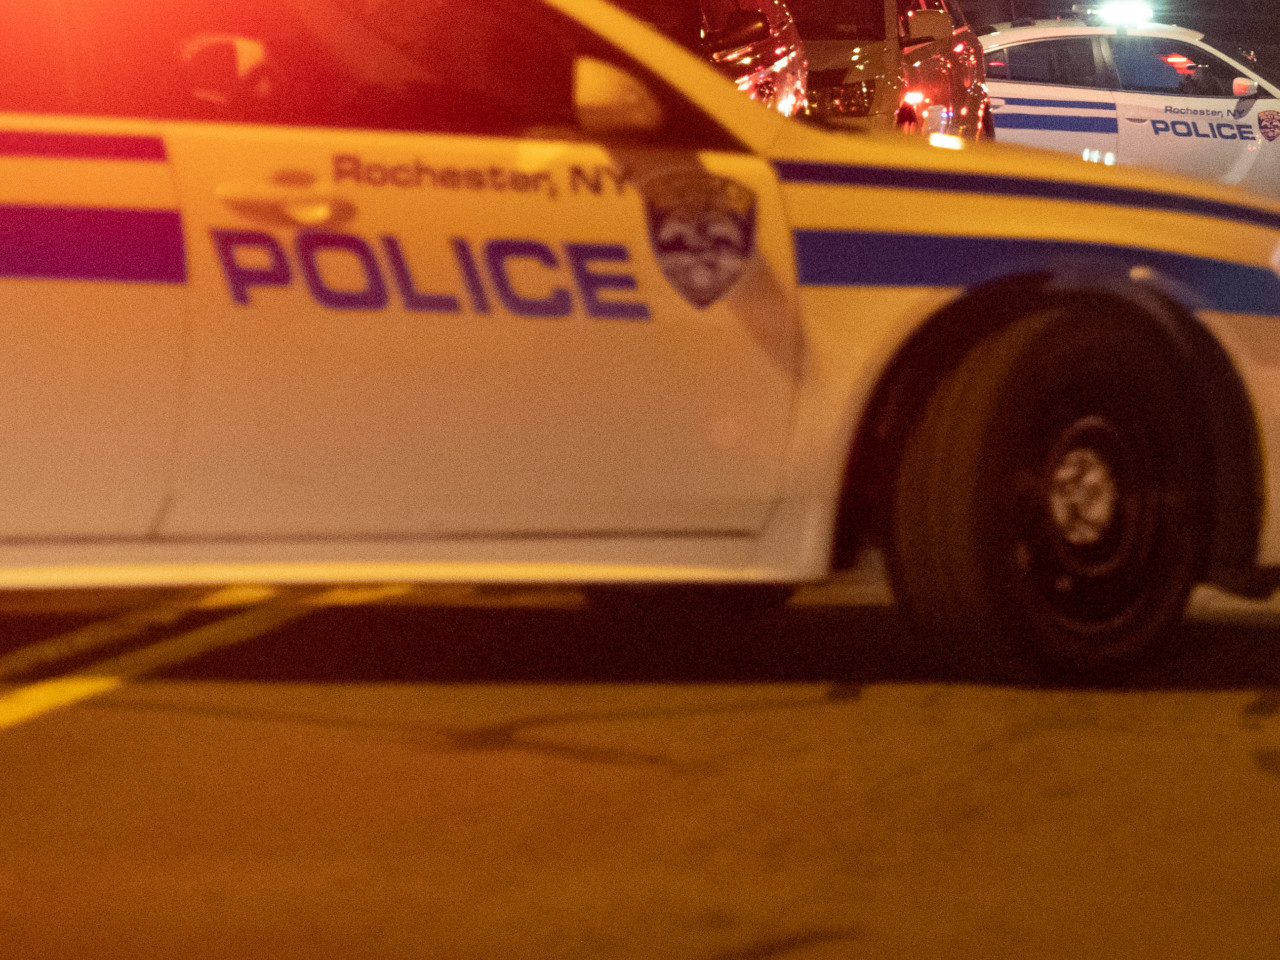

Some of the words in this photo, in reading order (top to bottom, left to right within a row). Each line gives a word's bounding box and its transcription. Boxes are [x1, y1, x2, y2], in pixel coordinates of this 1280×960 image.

[1164, 105, 1224, 118] Rochester,
[1226, 108, 1245, 118] NY
[1151, 120, 1257, 141] POLICE
[332, 152, 559, 201] Rochester,
[569, 162, 637, 197] NY
[208, 226, 653, 323] POLICE
